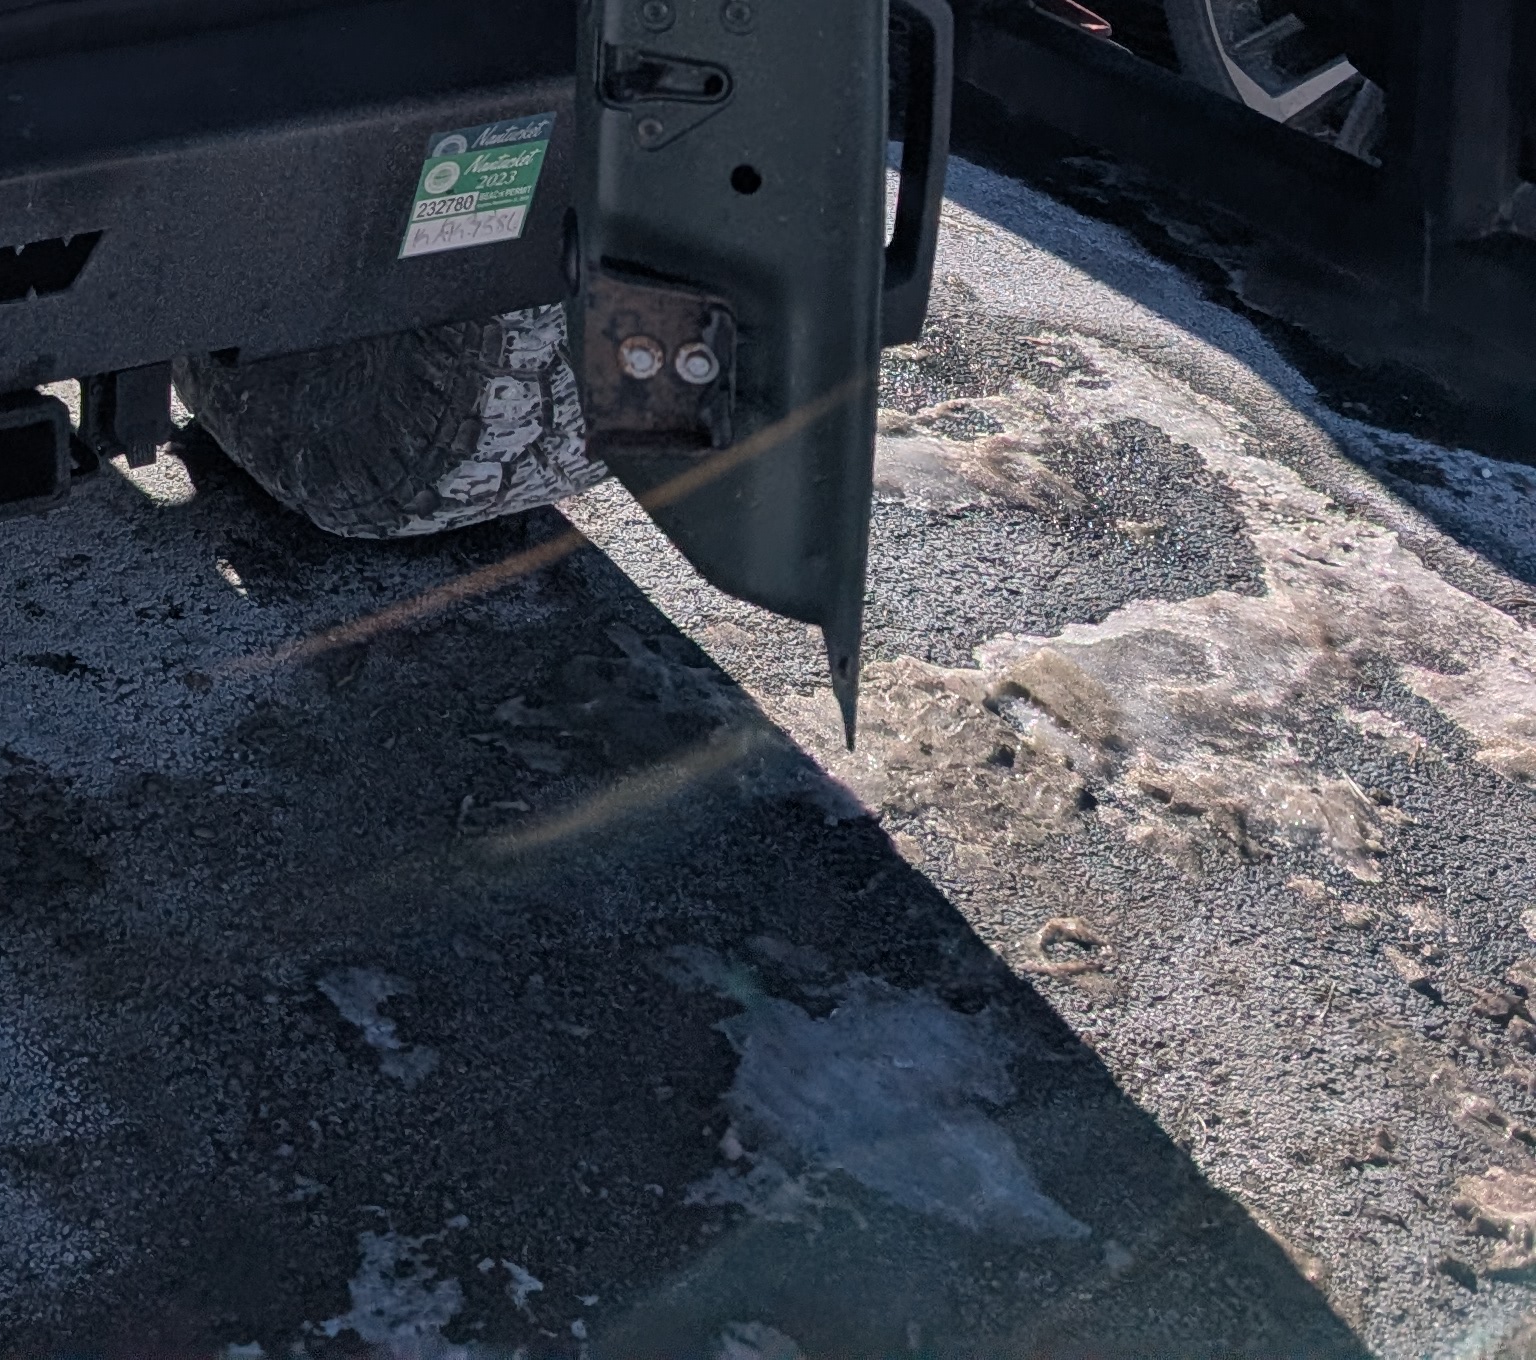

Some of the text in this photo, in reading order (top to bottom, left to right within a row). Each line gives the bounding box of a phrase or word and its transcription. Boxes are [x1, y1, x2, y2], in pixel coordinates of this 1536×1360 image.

[464, 148, 542, 175] Nantucket
[475, 170, 518, 189] 2023
[416, 194, 475, 219] 232780
